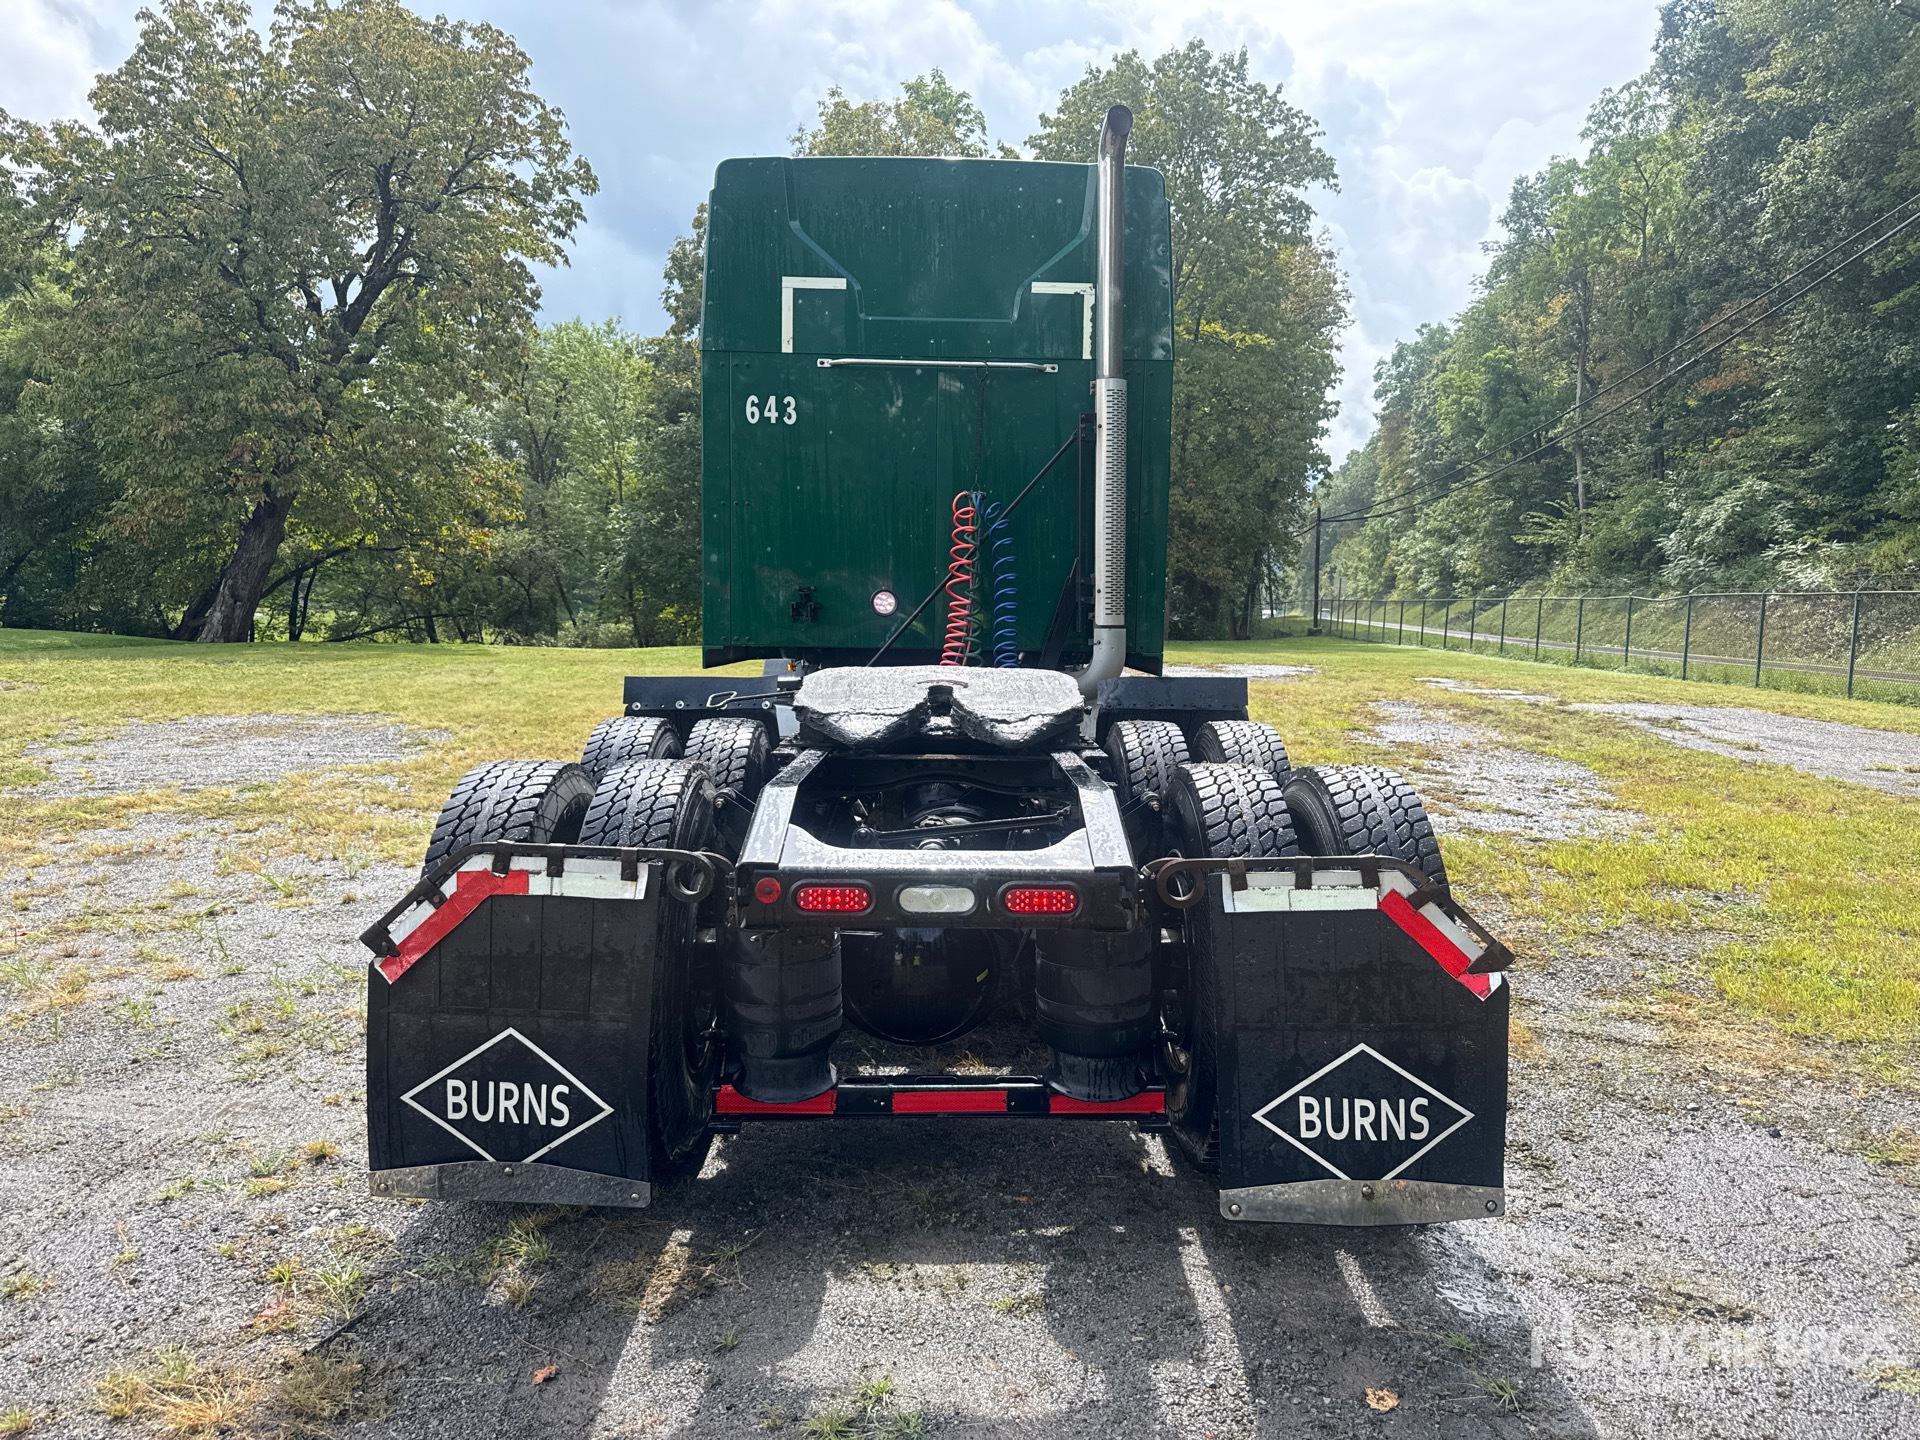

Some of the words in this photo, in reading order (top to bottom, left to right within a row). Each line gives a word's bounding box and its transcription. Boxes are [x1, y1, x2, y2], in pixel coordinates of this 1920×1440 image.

[746, 395, 797, 425] 643
[447, 1079, 570, 1127] BURNS
[1299, 1096, 1430, 1141] BURNS
